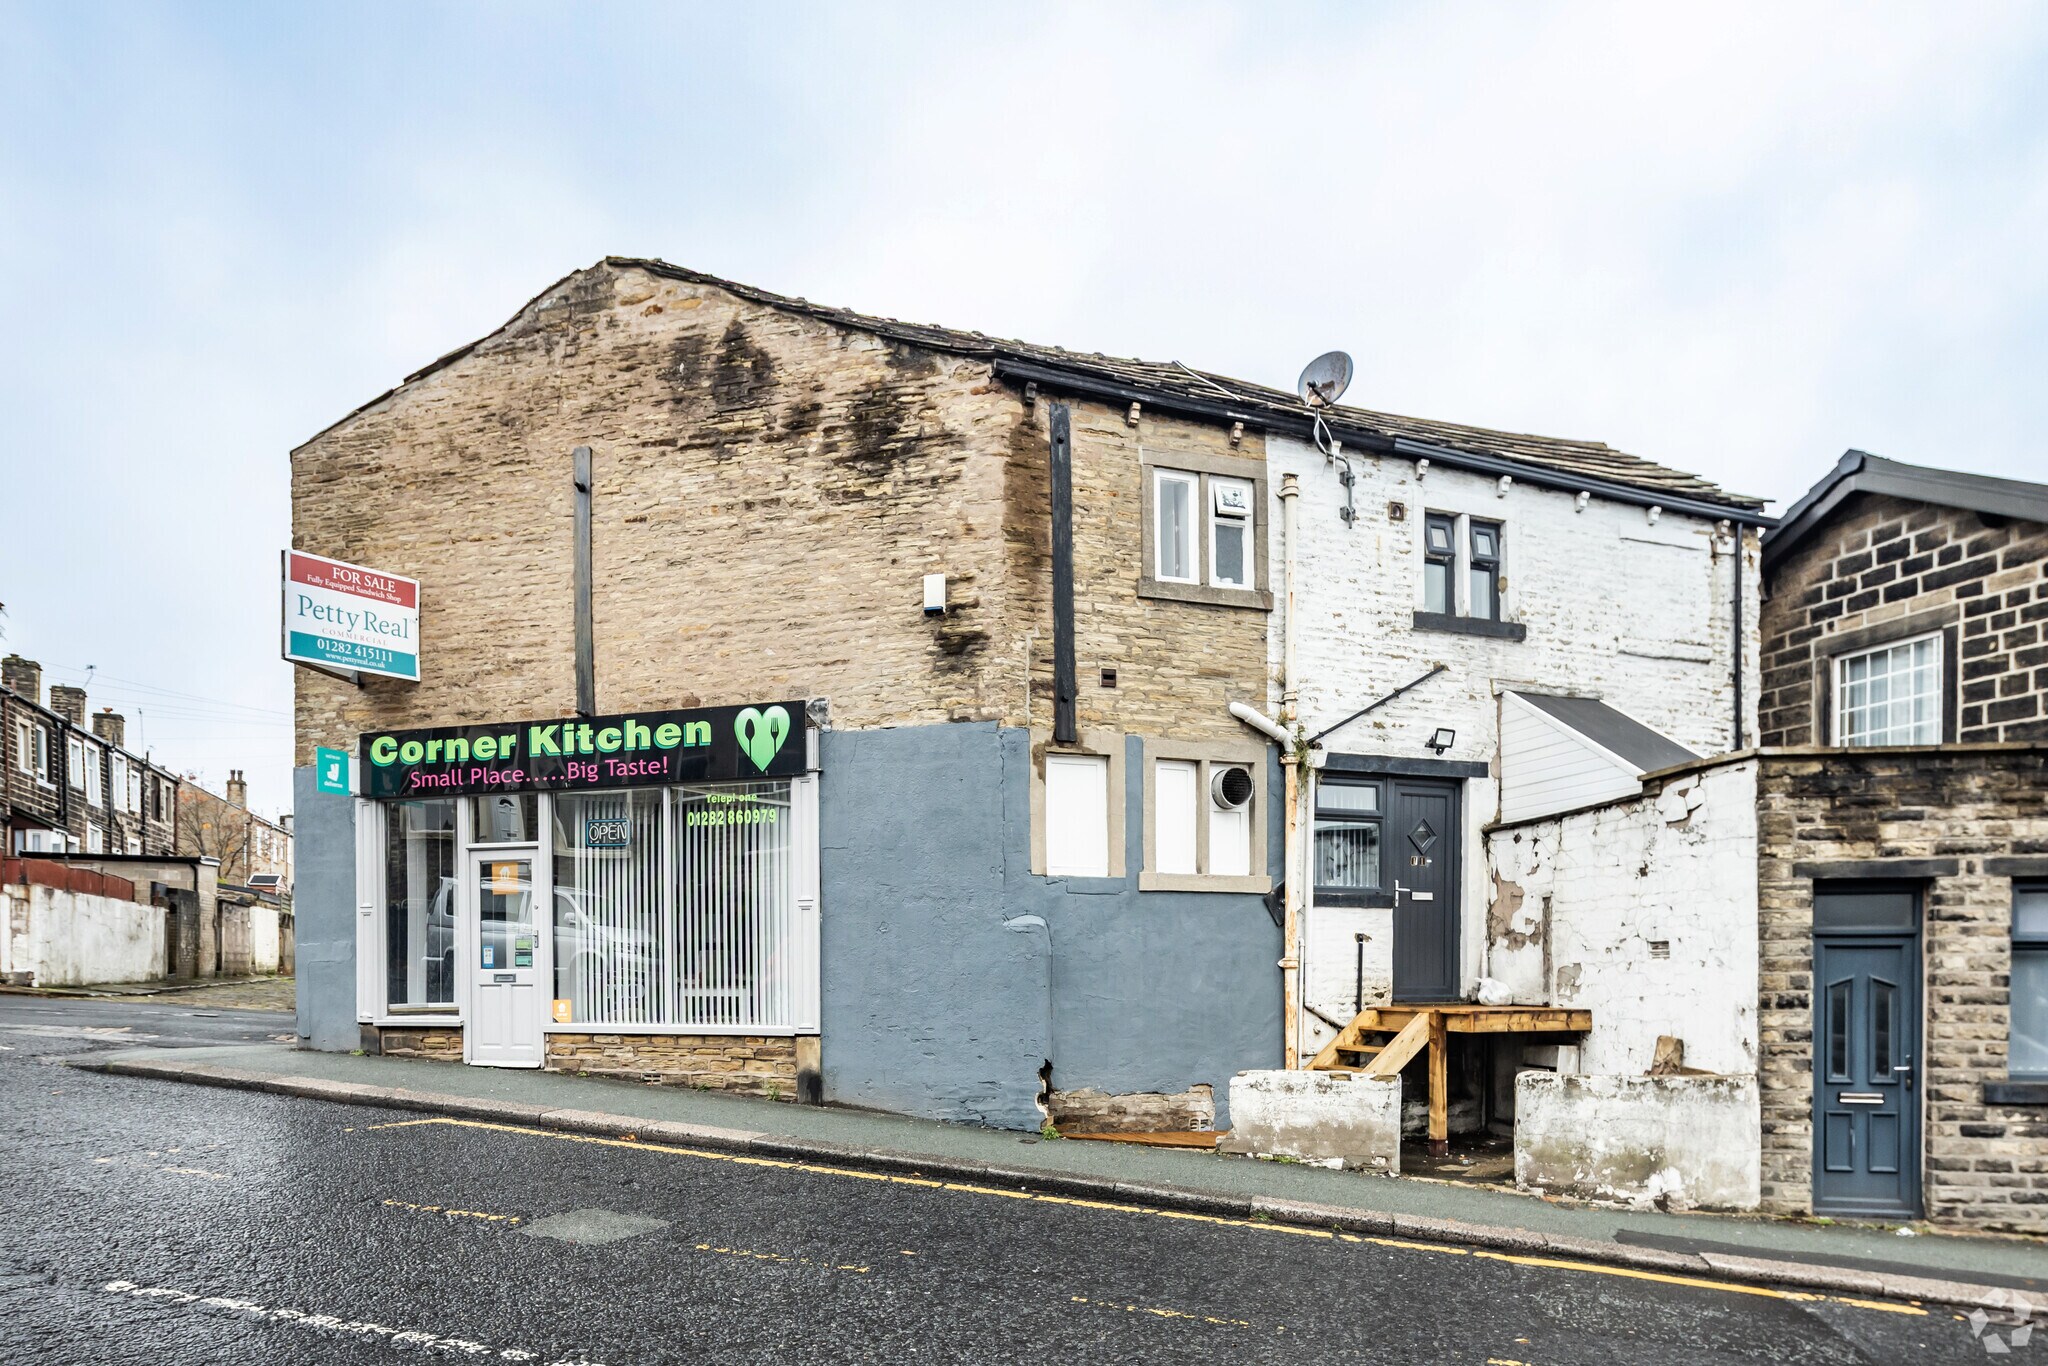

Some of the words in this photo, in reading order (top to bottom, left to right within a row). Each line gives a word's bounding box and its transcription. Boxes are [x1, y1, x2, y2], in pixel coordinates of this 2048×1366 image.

[307, 574, 323, 586] Fully
[325, 578, 355, 592] Equipped
[356, 583, 385, 599] Sandwich
[386, 590, 402, 604] Shop
[333, 567, 361, 585] FOR
[364, 575, 396, 593] SALE
[322, 627, 388, 646] COMMERCIAL
[317, 638, 352, 654] 01282
[354, 645, 393, 662] 415111
[325, 653, 386, 668] www.pettyreal.co.uk
[370, 733, 517, 767] Corner
[528, 719, 712, 758] Kitchen
[410, 768, 463, 789] Small
[604, 756, 668, 777] Taste!
[687, 810, 725, 827] 01282
[727, 808, 777, 825] 860979
[589, 824, 627, 841] OPEN
